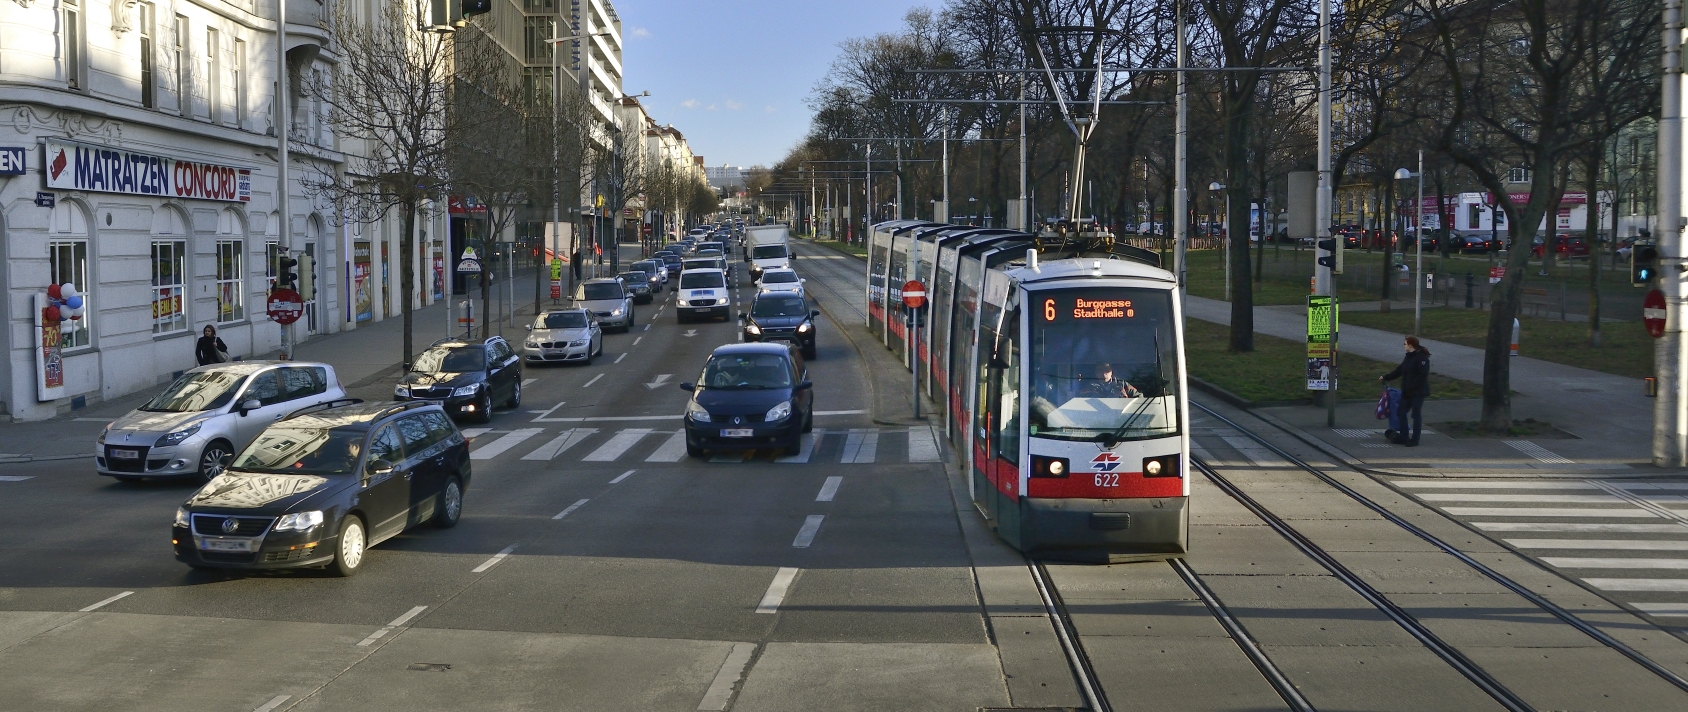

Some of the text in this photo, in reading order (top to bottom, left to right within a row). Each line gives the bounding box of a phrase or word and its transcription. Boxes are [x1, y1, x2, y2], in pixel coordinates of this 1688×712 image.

[75, 146, 168, 195] MATRATZEN
[174, 160, 236, 200] CONCORD
[1045, 299, 1056, 321] 6
[1077, 298, 1131, 309] Burggasse
[1073, 308, 1124, 318] Stadthalle
[1094, 473, 1119, 487] 622
